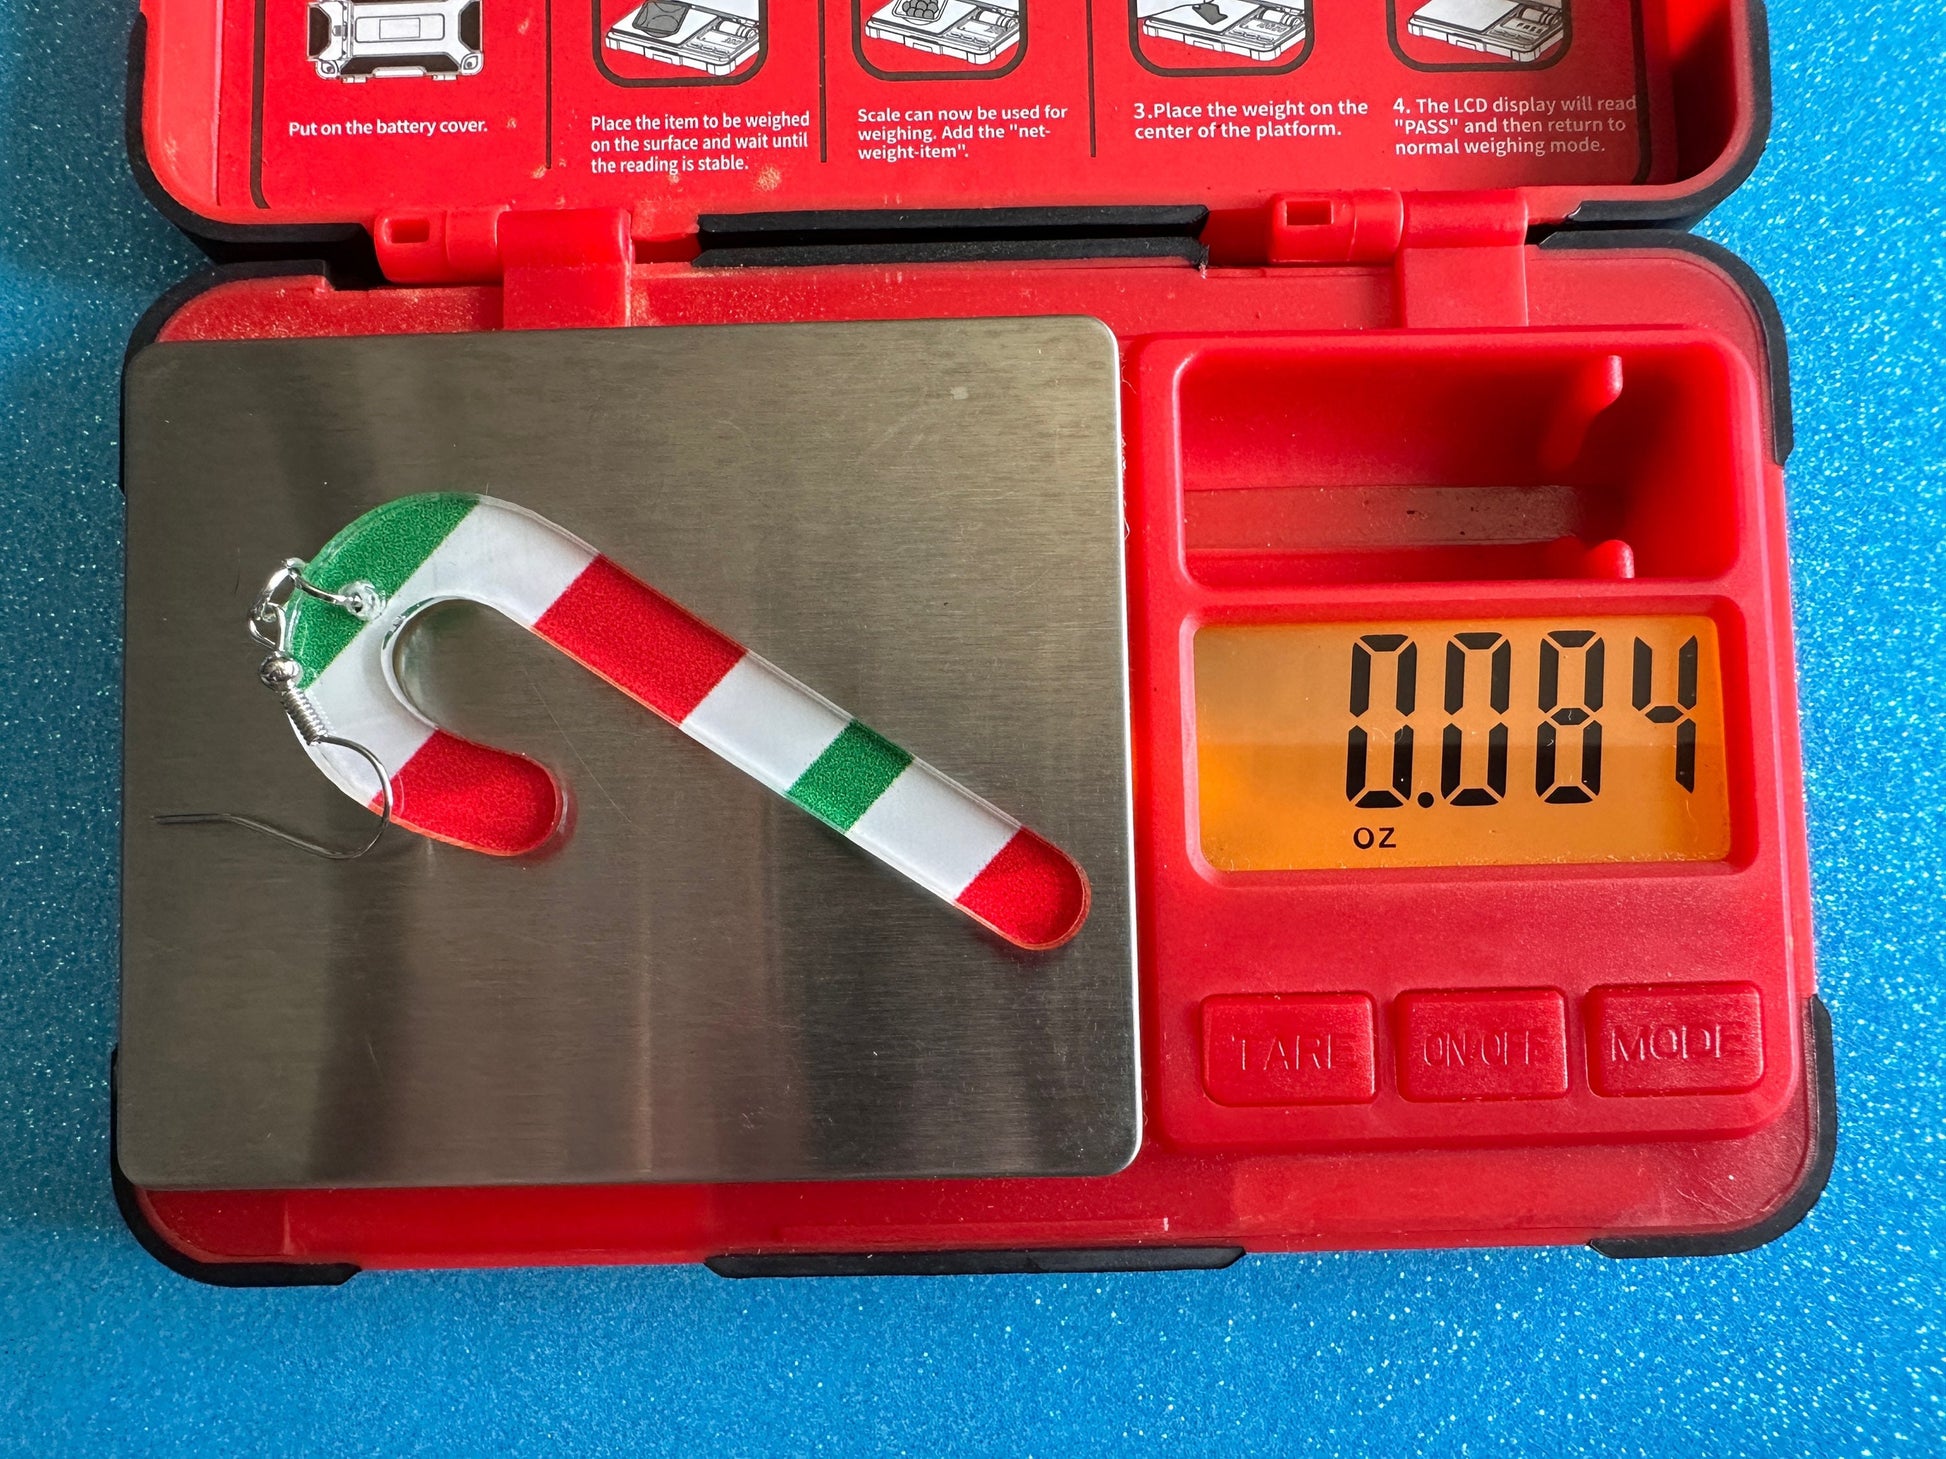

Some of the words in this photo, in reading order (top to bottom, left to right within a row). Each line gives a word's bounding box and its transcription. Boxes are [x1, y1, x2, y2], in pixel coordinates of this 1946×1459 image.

[857, 106, 901, 123] Scale
[904, 109, 934, 122] can
[937, 109, 974, 121] now
[976, 105, 998, 121] be
[1001, 104, 1041, 120] used
[1043, 103, 1069, 120] for
[1205, 100, 1238, 118] the
[1241, 99, 1306, 121] weight
[1309, 103, 1334, 116] on
[1337, 98, 1369, 116] the
[1392, 96, 1411, 115] 4.
[1415, 97, 1450, 114] The
[1453, 97, 1488, 114] LCD
[1492, 96, 1557, 116] display
[1560, 95, 1593, 112] will
[1597, 94, 1637, 111] read
[287, 120, 319, 138] Put
[319, 122, 343, 136] on
[344, 118, 374, 136] the
[375, 118, 437, 137] battery
[438, 119, 489, 134] cover.
[590, 114, 633, 132] Place
[634, 113, 661, 131] the
[664, 113, 700, 130] item
[702, 113, 720, 130] to
[722, 111, 742, 129] be
[744, 109, 810, 132] weighed
[1134, 123, 1194, 140] center
[1197, 121, 1217, 139] of
[1220, 121, 1252, 139] the
[1255, 120, 1342, 142] platform.
[1394, 117, 1459, 135] "PASS"
[1463, 116, 1498, 134] and
[1501, 116, 1543, 133] then
[1547, 117, 1603, 132] return
[1607, 117, 1627, 132] to
[590, 139, 611, 153] on
[613, 135, 640, 152] the
[642, 134, 699, 152] surface
[702, 133, 732, 150] and
[734, 132, 769, 150] wait
[772, 131, 809, 149] until
[857, 125, 937, 144] weighing.
[941, 124, 974, 140] Add
[977, 123, 1006, 139] the
[1009, 123, 1052, 139] "net-
[857, 143, 969, 163] weight-item".
[1395, 137, 1460, 156] normal
[1463, 136, 1546, 158] weighing
[1550, 136, 1606, 153] mode.
[590, 156, 617, 175] the
[619, 155, 679, 177] reading
[681, 156, 695, 172] is
[698, 153, 750, 172] stable.
[1345, 630, 1698, 809] 0.084
[1231, 1033, 1357, 1070] TARE
[1610, 1023, 1745, 1061] MODE
